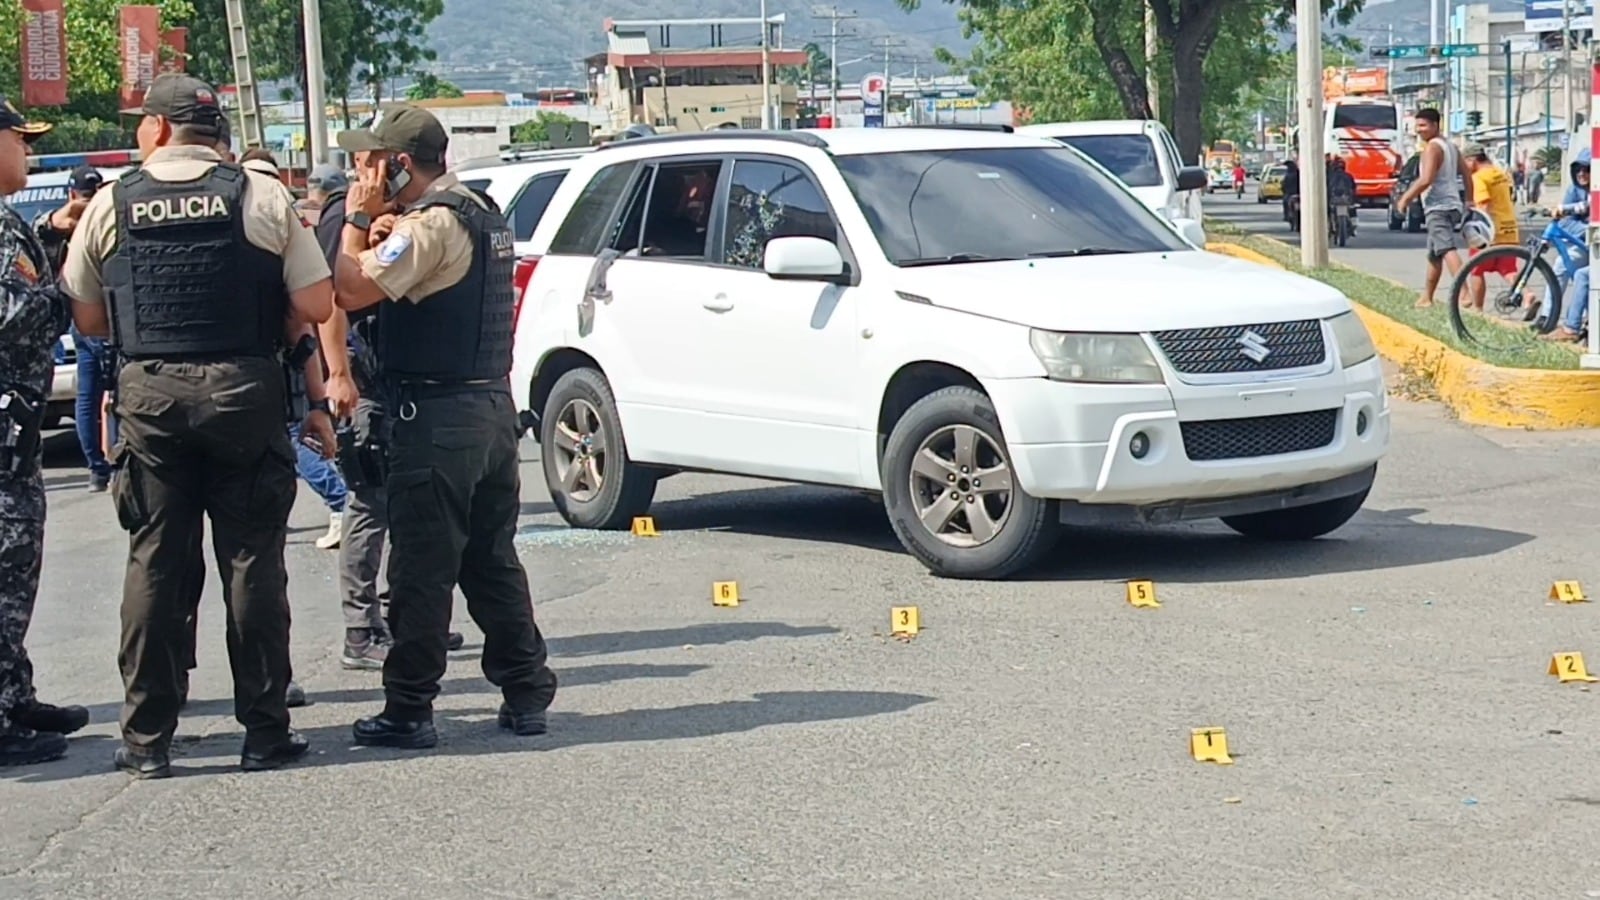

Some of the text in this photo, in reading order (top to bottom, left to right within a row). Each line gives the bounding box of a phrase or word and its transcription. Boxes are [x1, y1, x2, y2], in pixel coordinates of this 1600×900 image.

[43, 10, 61, 81] CIUDADANA
[132, 196, 228, 224] POLICIA
[640, 519, 648, 532] 7
[721, 584, 729, 598] 6
[1136, 584, 1146, 599] 5
[1564, 583, 1574, 596] 4
[900, 610, 909, 625] 3
[1564, 655, 1577, 672] 2
[1204, 730, 1212, 747] 1
